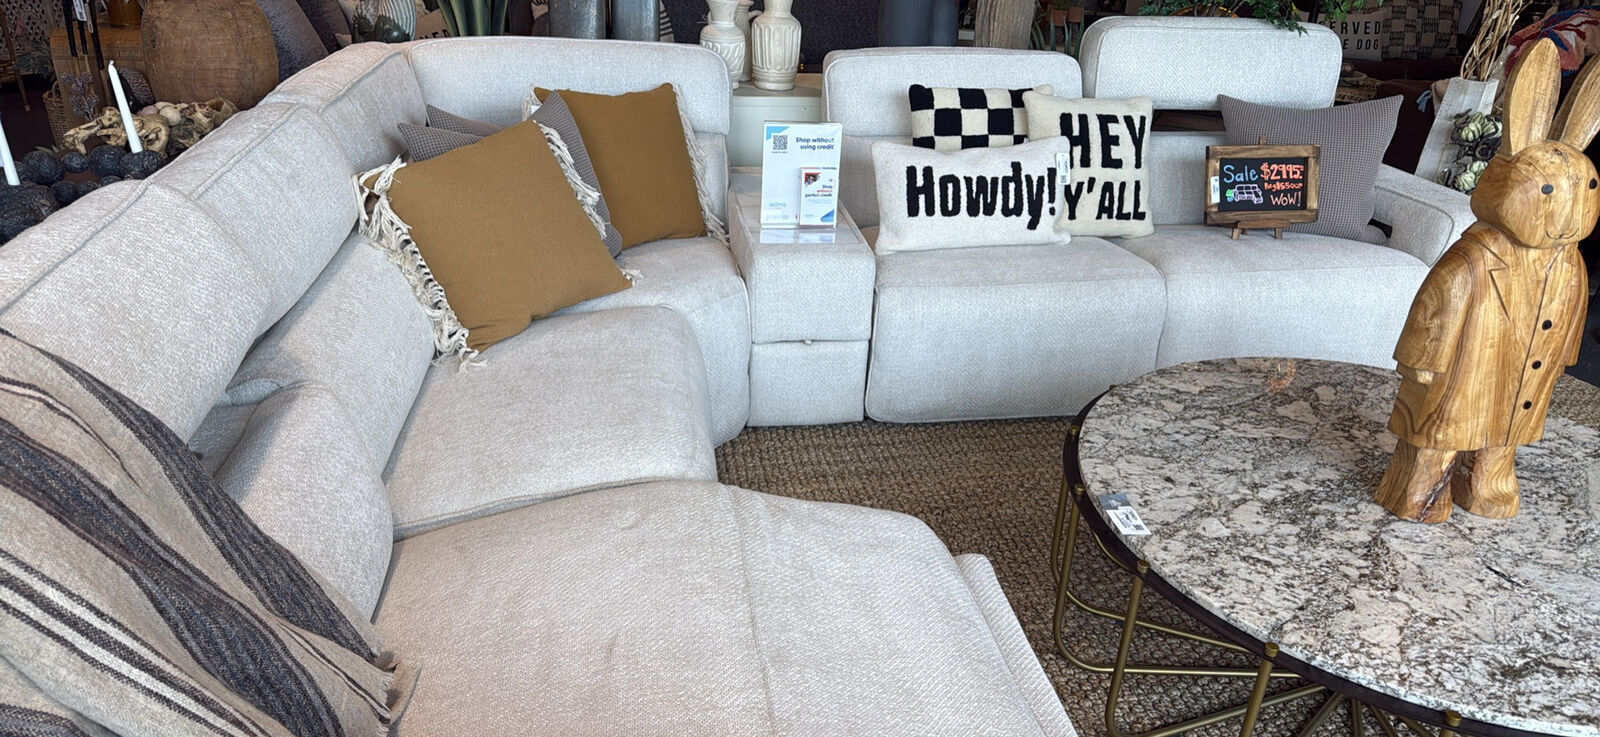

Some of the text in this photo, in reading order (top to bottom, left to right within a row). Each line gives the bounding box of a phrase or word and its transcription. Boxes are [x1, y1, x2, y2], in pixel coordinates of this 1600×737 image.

[1356, 38, 1379, 50] DOG
[1059, 112, 1147, 169] HEY
[906, 160, 1057, 231] Howdy!
[1223, 164, 1258, 183] Sale
[1064, 176, 1147, 221] Y'ALL
